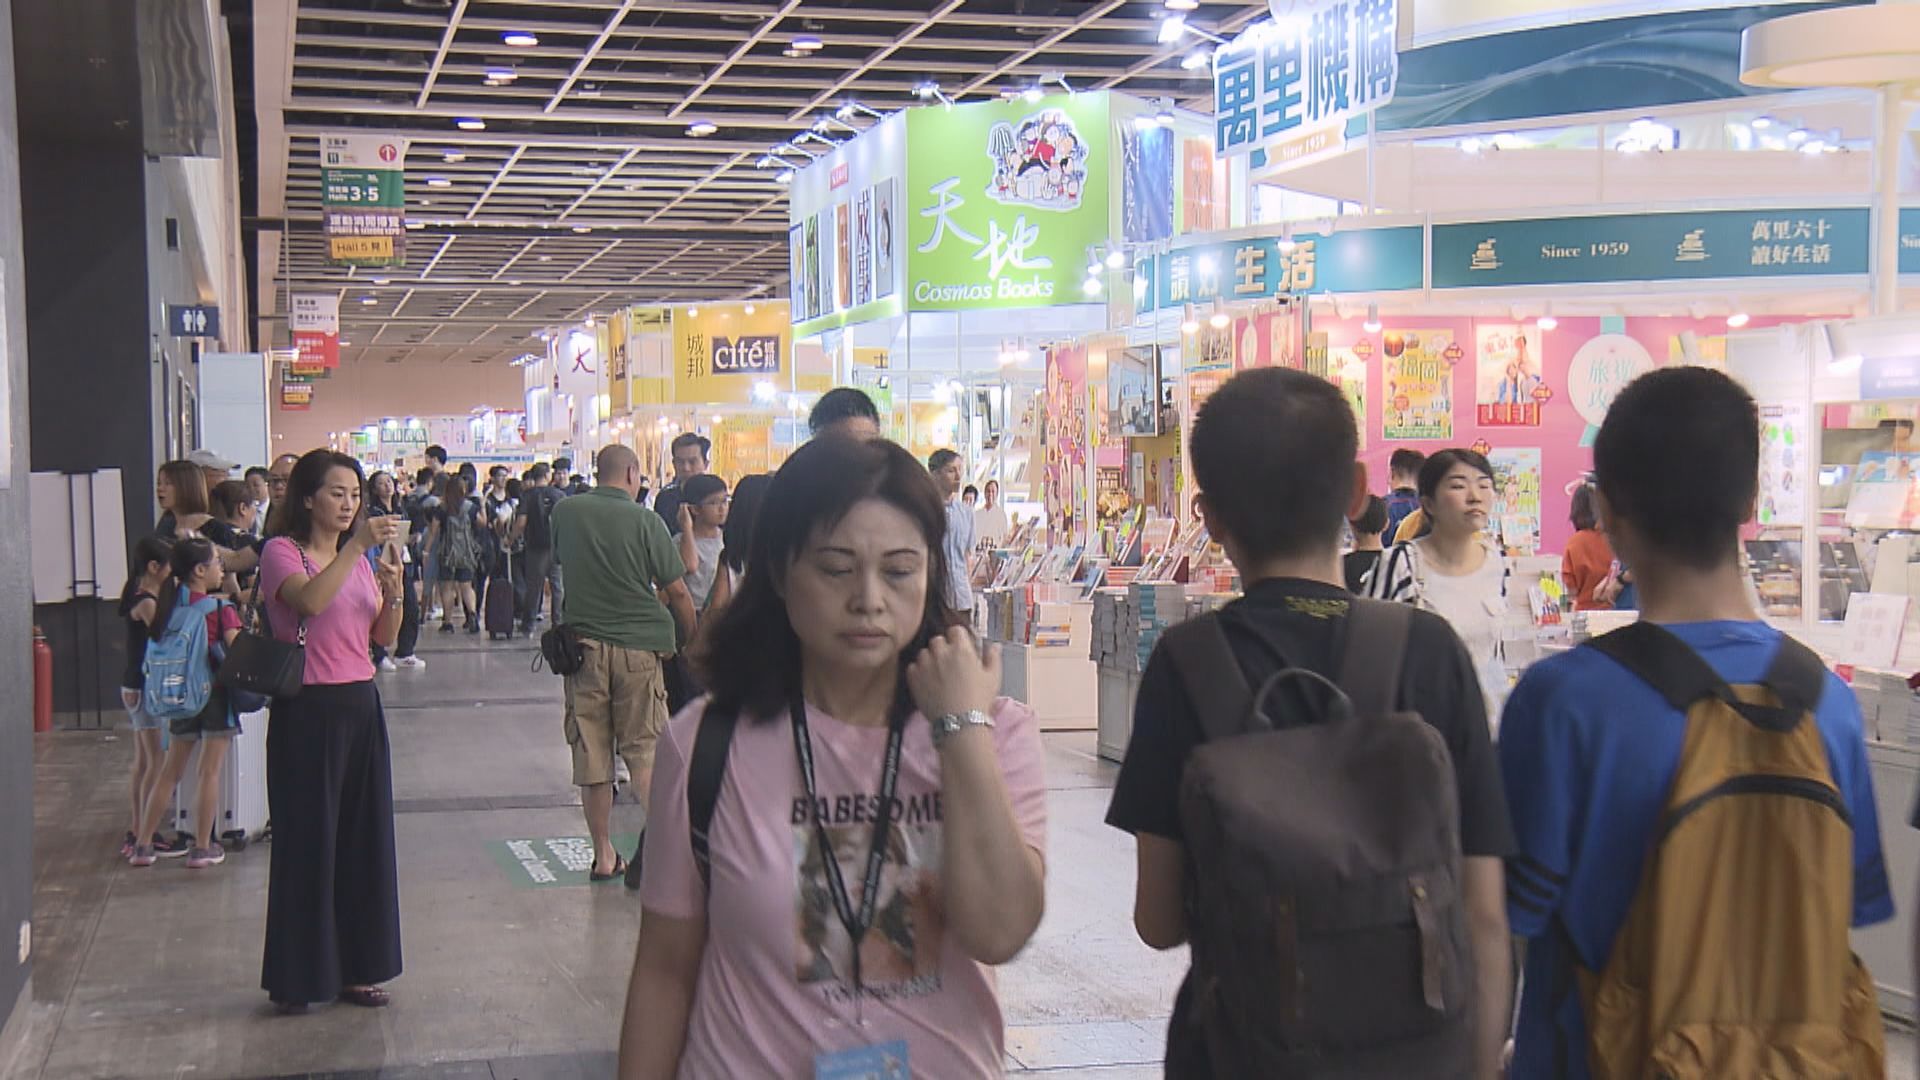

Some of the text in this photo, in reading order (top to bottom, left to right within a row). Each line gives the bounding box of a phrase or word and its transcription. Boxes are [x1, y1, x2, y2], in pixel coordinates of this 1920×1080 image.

[917, 176, 1053, 281] 天地
[1752, 219, 1832, 241] 萬里六十
[337, 242, 358, 253] Hall
[1541, 241, 1629, 258] Since 1959
[1751, 244, 1831, 266] 讀好生活
[914, 275, 1054, 302] Cosmos Books
[687, 334, 704, 379] 城邦
